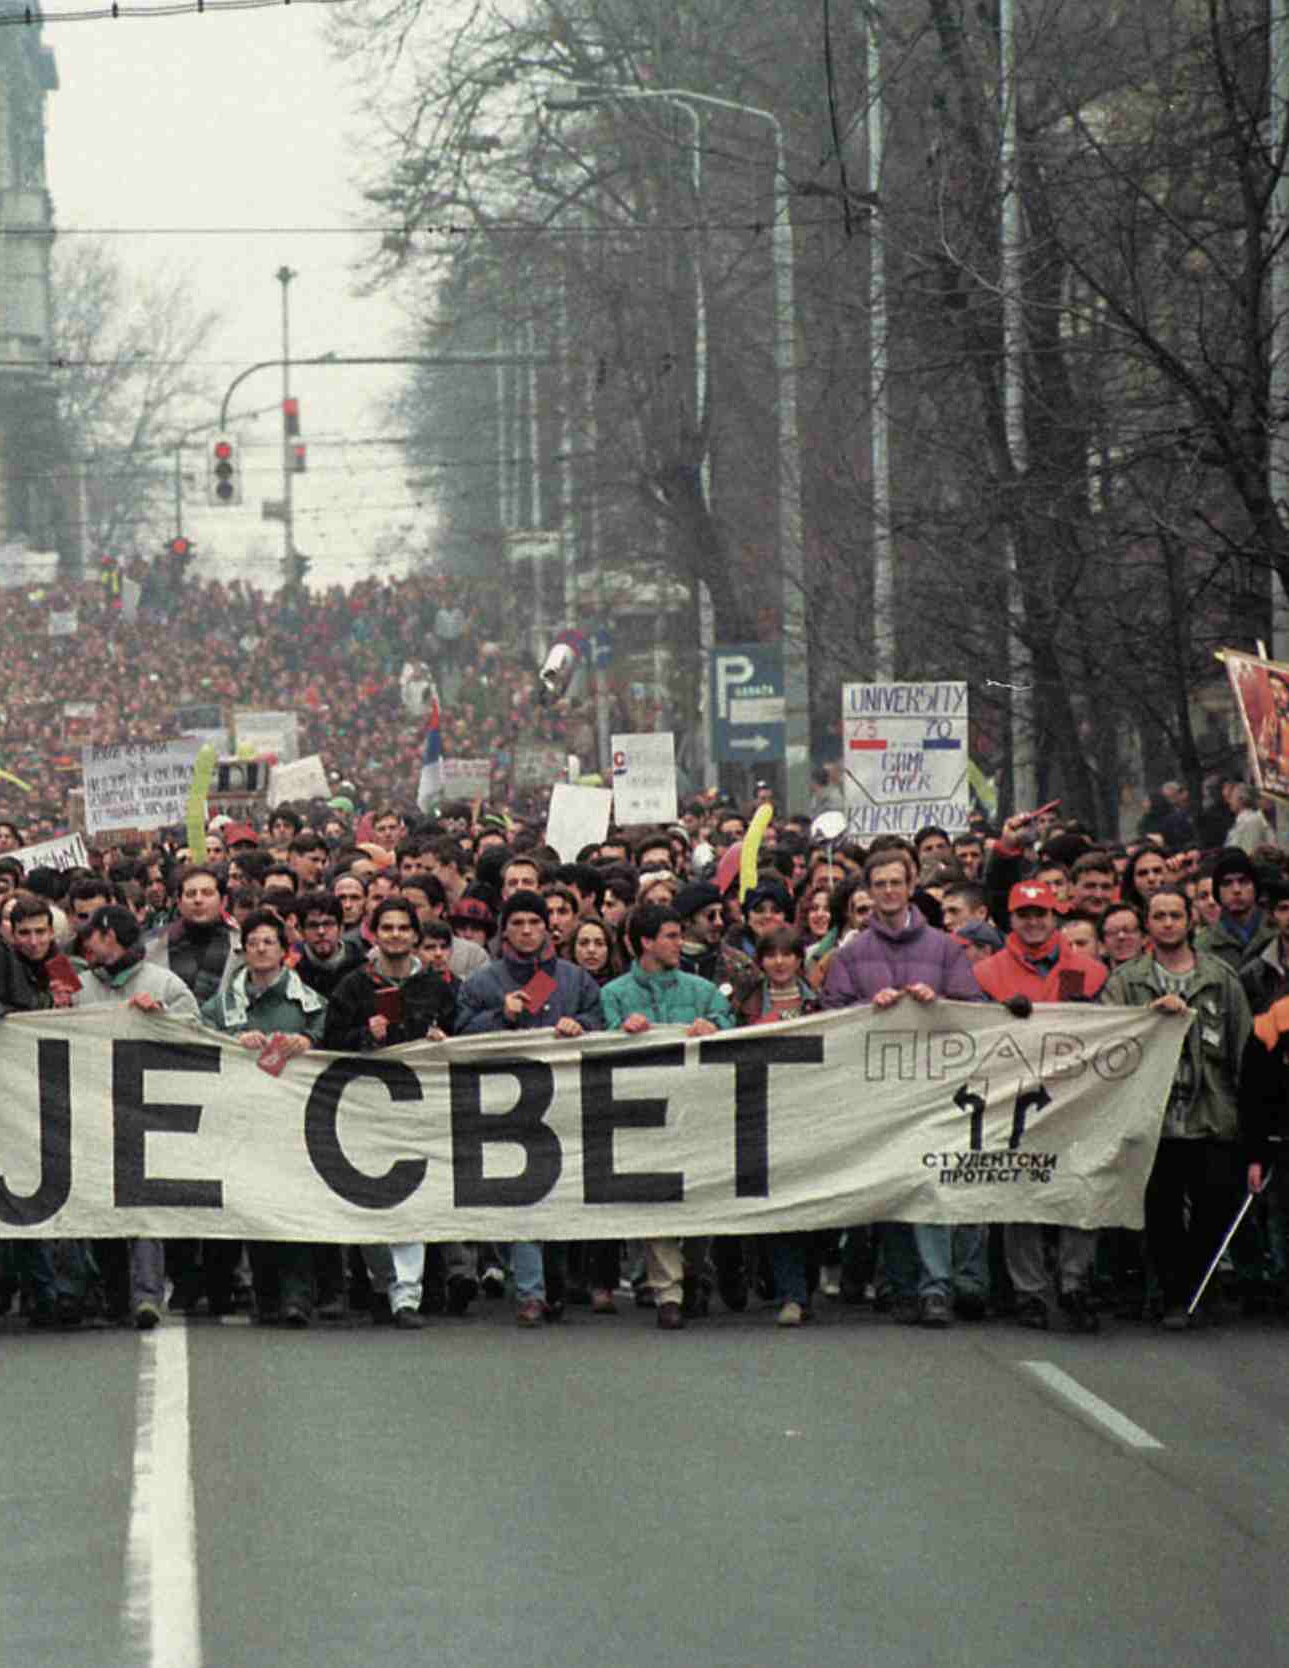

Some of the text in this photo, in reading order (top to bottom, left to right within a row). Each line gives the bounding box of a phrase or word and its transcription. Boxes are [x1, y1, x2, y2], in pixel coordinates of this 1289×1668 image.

[716, 656, 754, 719] P
[850, 684, 967, 713] UNIVERSITY
[864, 1029, 1144, 1083] ПРАВО
[304, 1035, 824, 1209] СВЕТ
[922, 1152, 1060, 1171] СТУДЕНТСКИ
[939, 1168, 1023, 1185] ПРОТЕСТ
